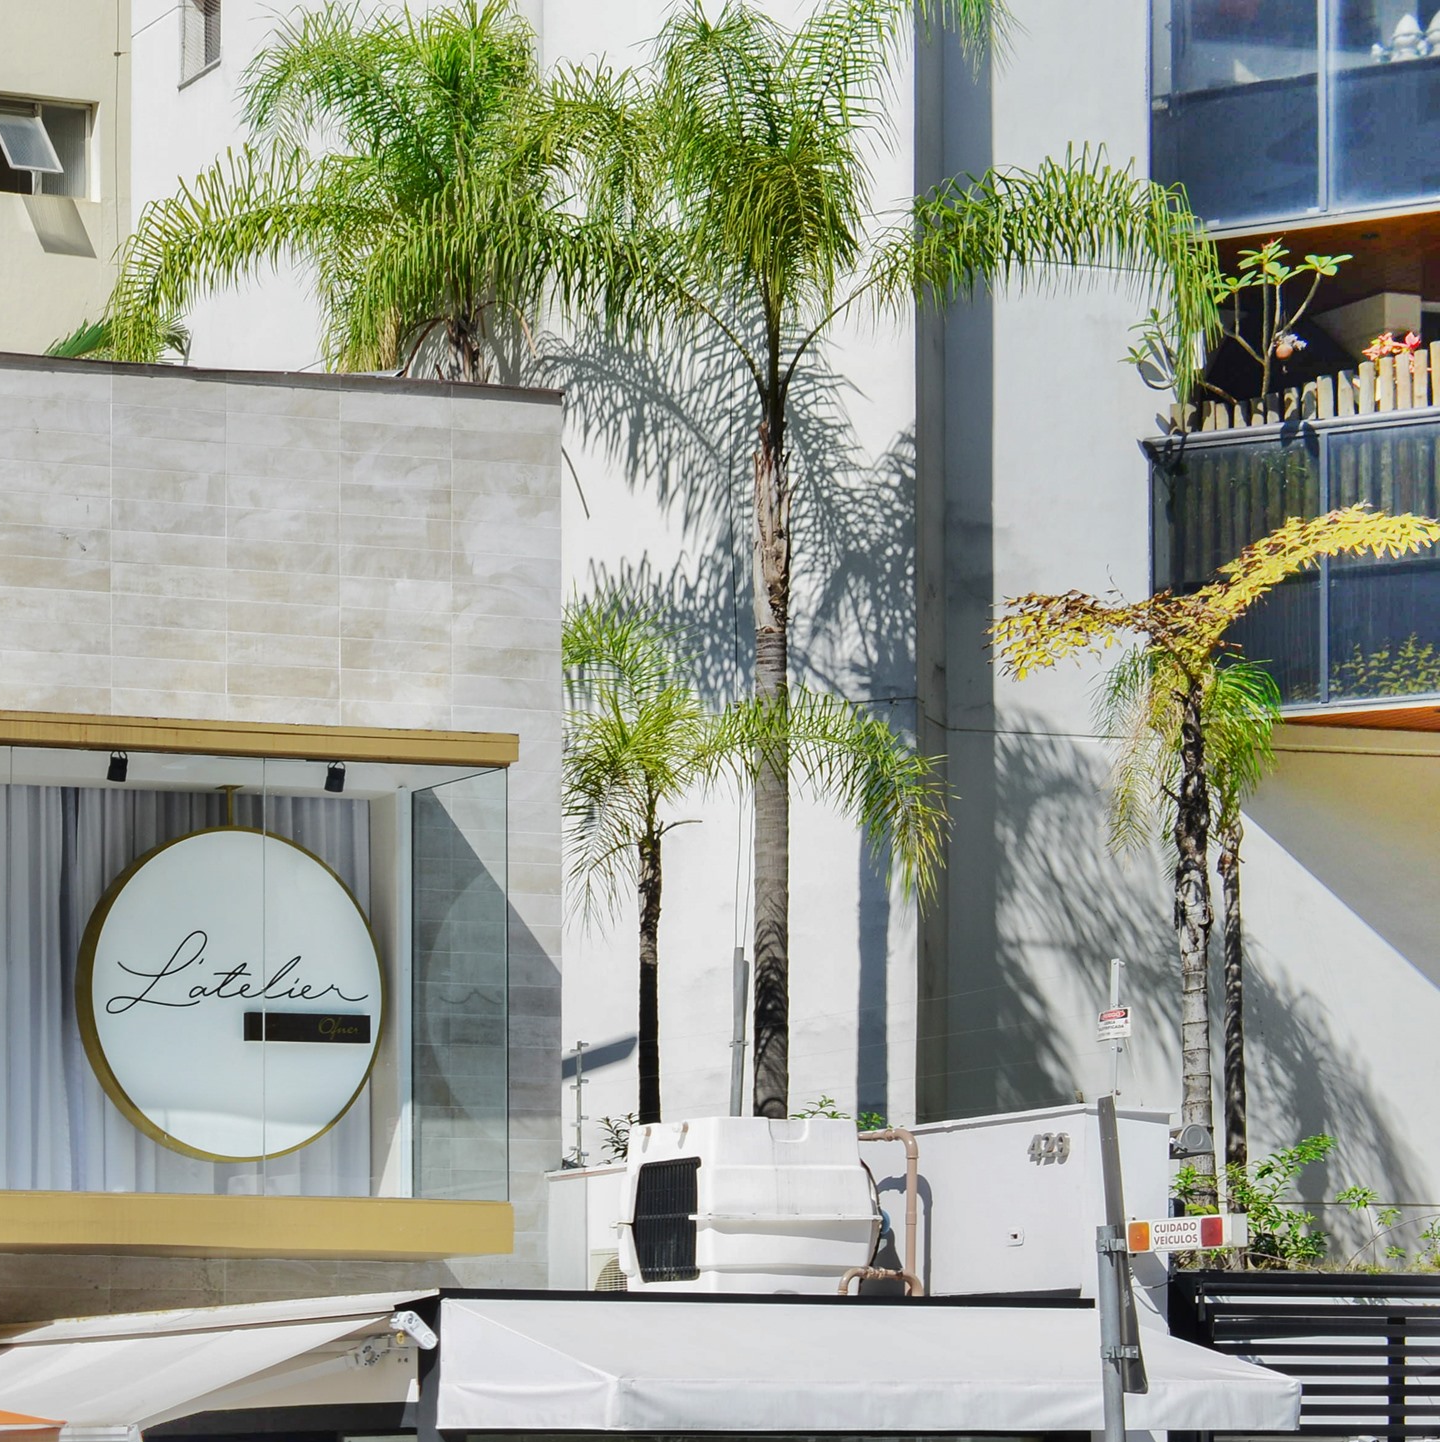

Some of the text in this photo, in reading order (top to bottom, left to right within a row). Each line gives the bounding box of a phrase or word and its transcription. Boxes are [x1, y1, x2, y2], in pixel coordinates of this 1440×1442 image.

[318, 1016, 360, 1041] Ofner
[1154, 1222, 1197, 1233] CUIDADO
[1154, 1234, 1198, 1245] VEÍCULOS
